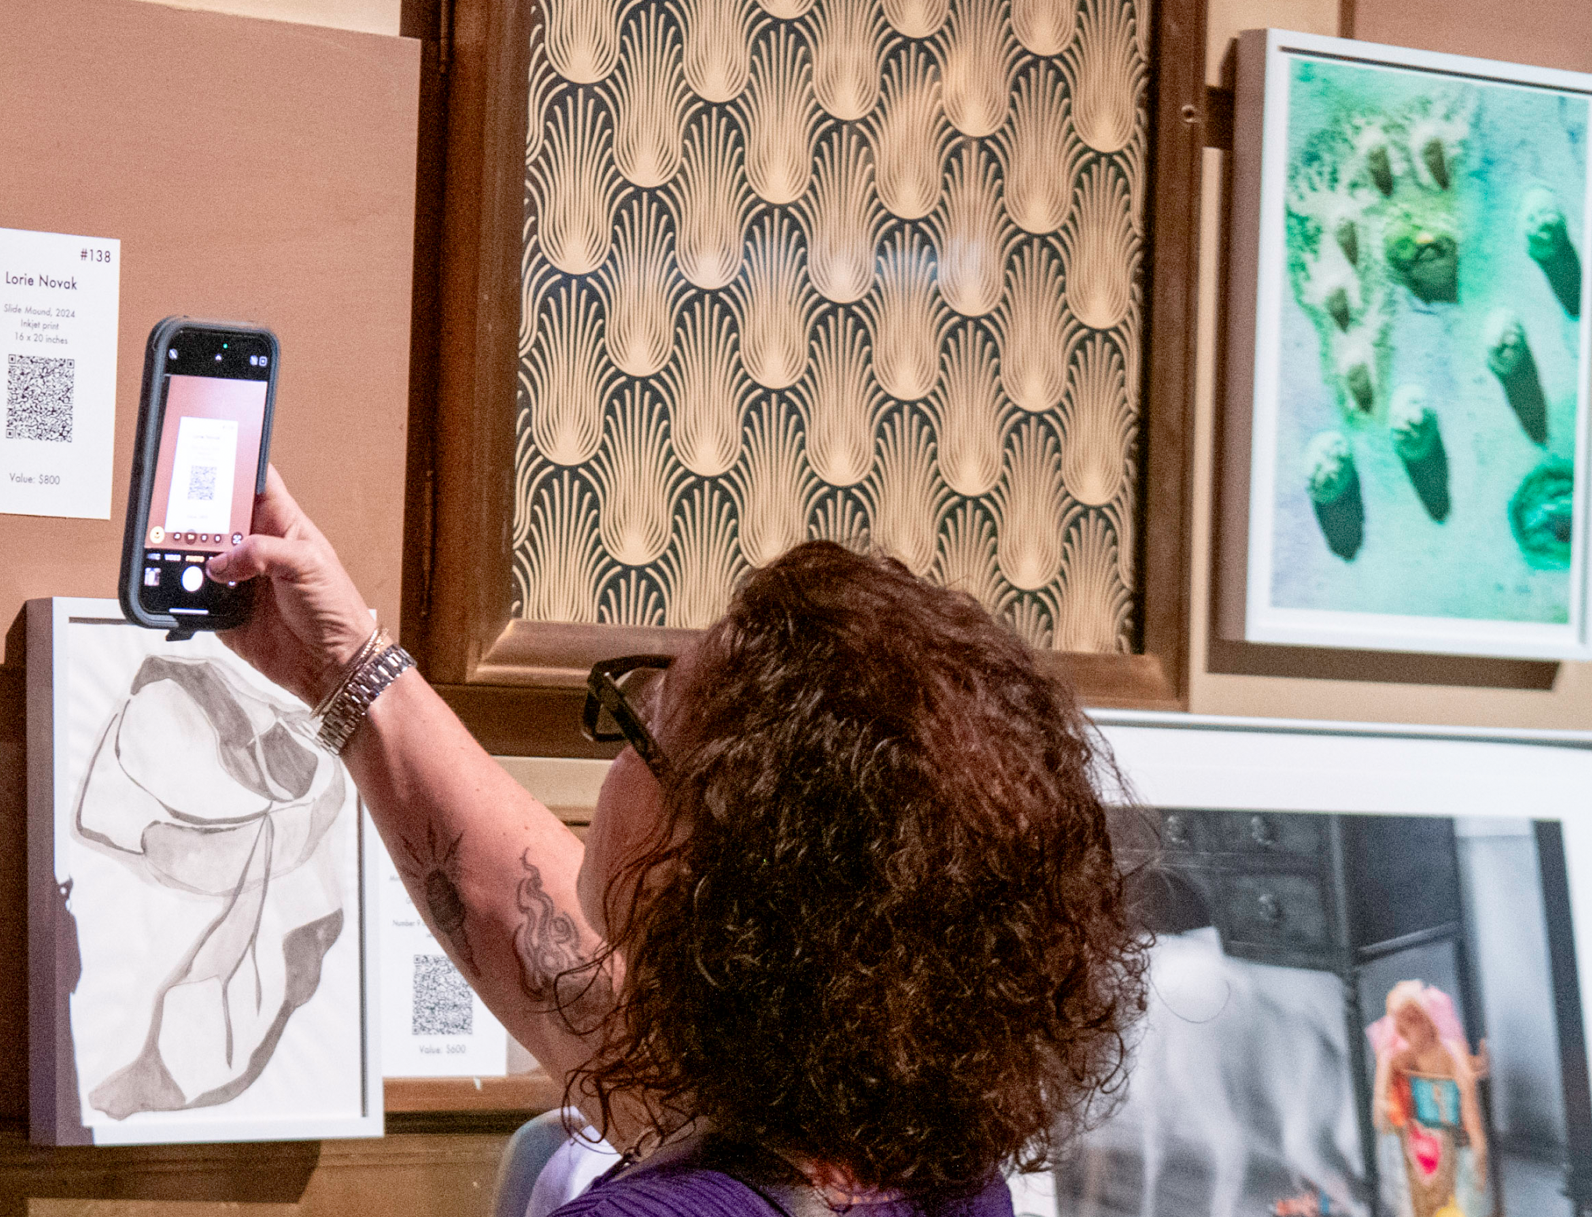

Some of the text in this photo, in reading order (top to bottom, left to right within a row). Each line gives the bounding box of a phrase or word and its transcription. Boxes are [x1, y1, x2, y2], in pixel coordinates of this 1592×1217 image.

[80, 248, 111, 263] #138
[6, 271, 77, 290] Lorie Novak
[4, 304, 75, 318] Slide Mound, 2024
[21, 319, 59, 332] Inkjet print
[15, 332, 24, 341] 16
[34, 333, 43, 342] 20
[46, 334, 68, 344] inches
[10, 473, 60, 485] Value: $800
